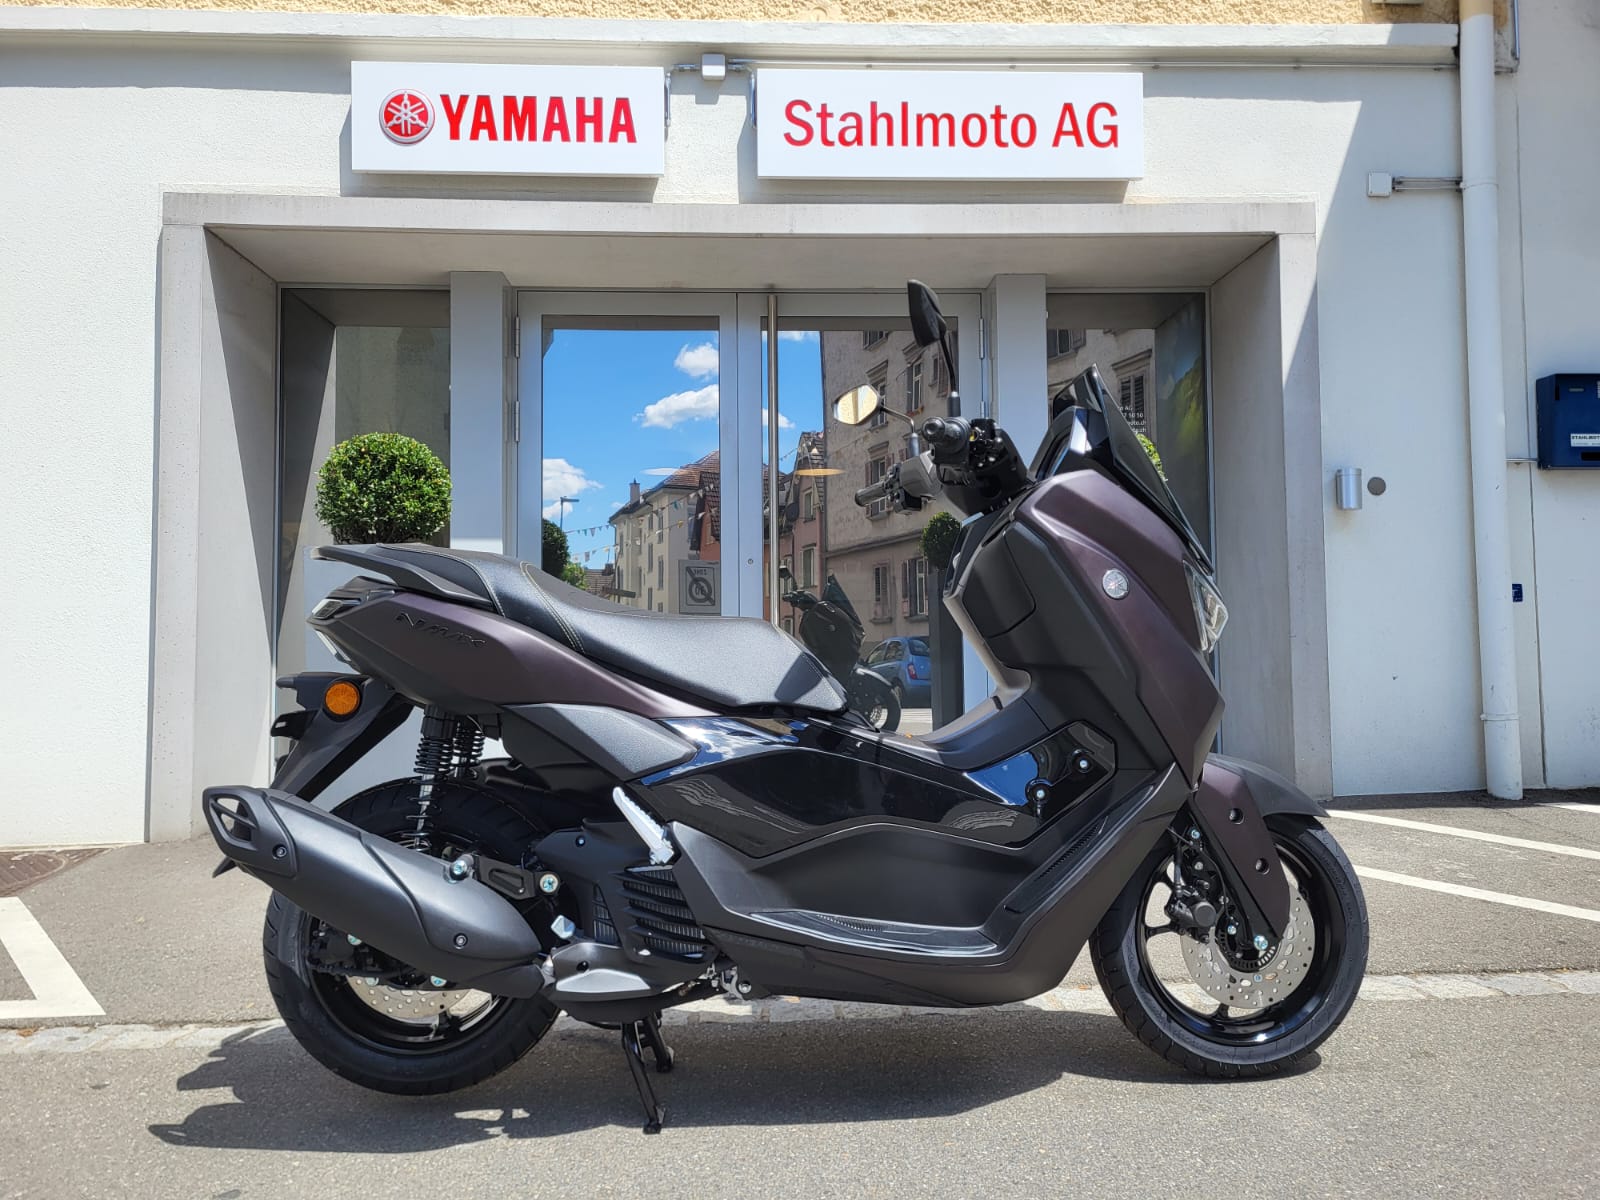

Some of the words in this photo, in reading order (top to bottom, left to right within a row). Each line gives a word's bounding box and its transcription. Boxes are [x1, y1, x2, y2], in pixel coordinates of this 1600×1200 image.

[439, 94, 638, 143] YAMAHA
[783, 98, 1038, 148] Stahlmoto
[1051, 102, 1120, 148] AG
